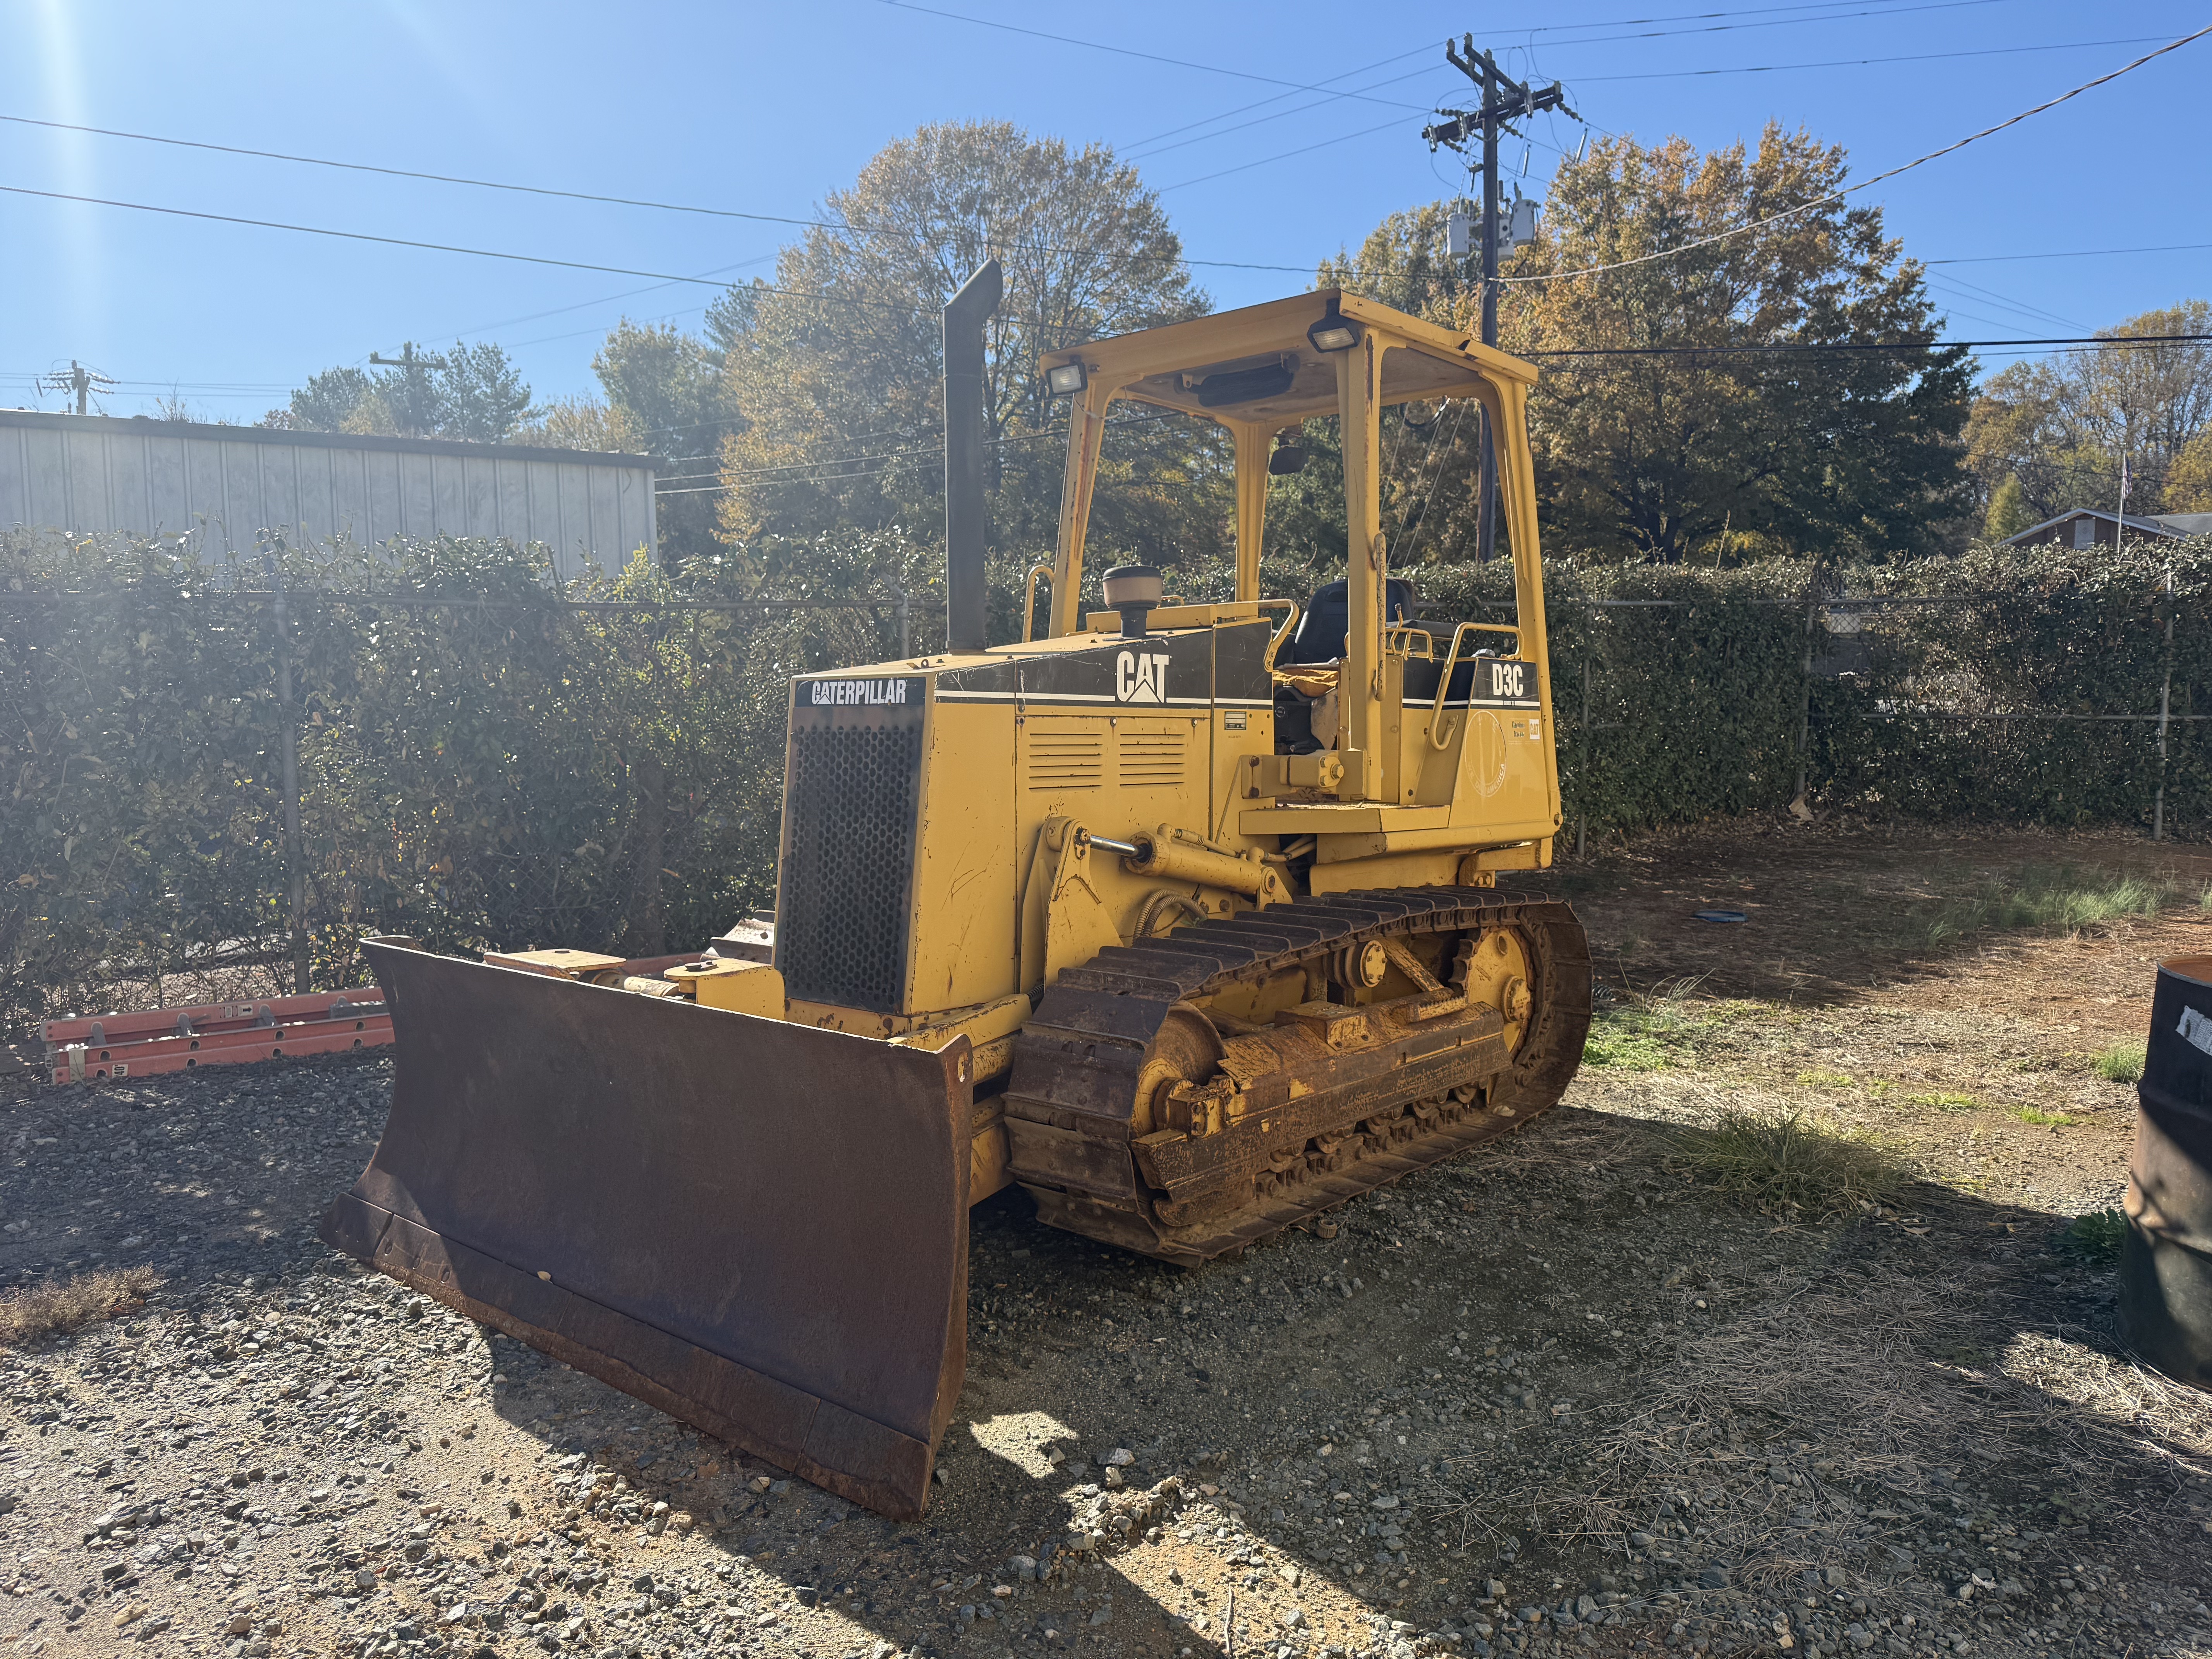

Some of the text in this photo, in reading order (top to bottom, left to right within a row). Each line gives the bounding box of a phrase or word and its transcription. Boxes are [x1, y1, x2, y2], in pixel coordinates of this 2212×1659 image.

[812, 680, 906, 704] CATERPILLAR
[1117, 651, 1169, 703] CAT
[1492, 663, 1523, 697] D3C
